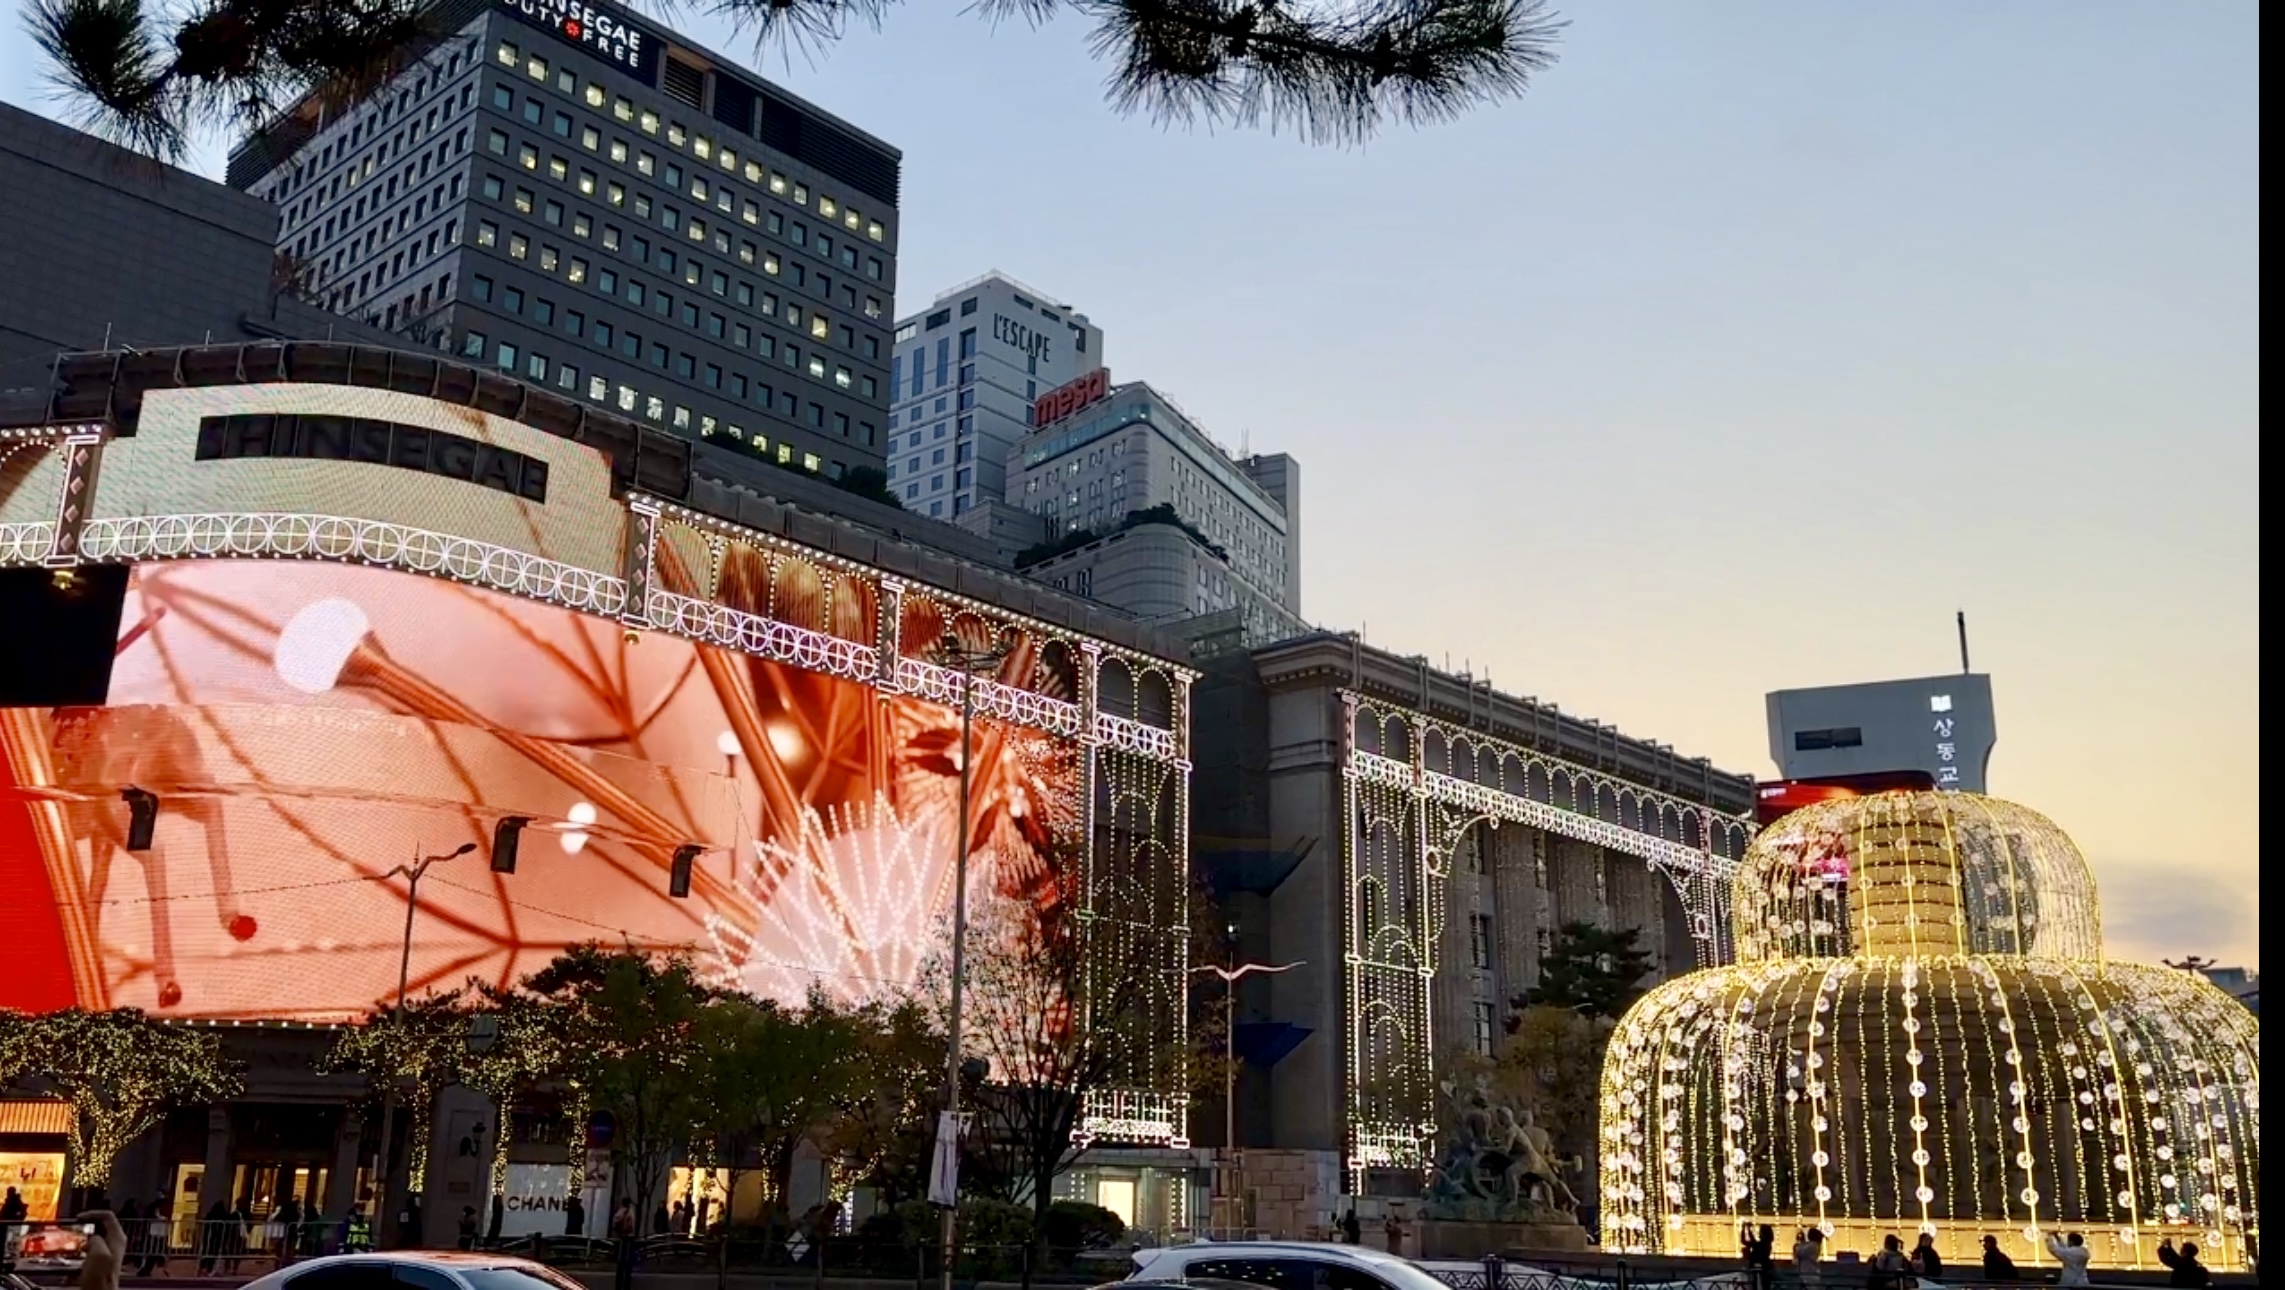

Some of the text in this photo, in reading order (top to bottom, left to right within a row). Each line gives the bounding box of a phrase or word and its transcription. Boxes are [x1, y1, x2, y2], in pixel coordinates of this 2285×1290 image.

[582, 28, 638, 67] FREE
[994, 313, 1050, 362] L'ESCAPE
[1034, 371, 1106, 428] mesa
[200, 415, 547, 502] SHINSEGAE
[1933, 718, 1959, 793] 상동교
